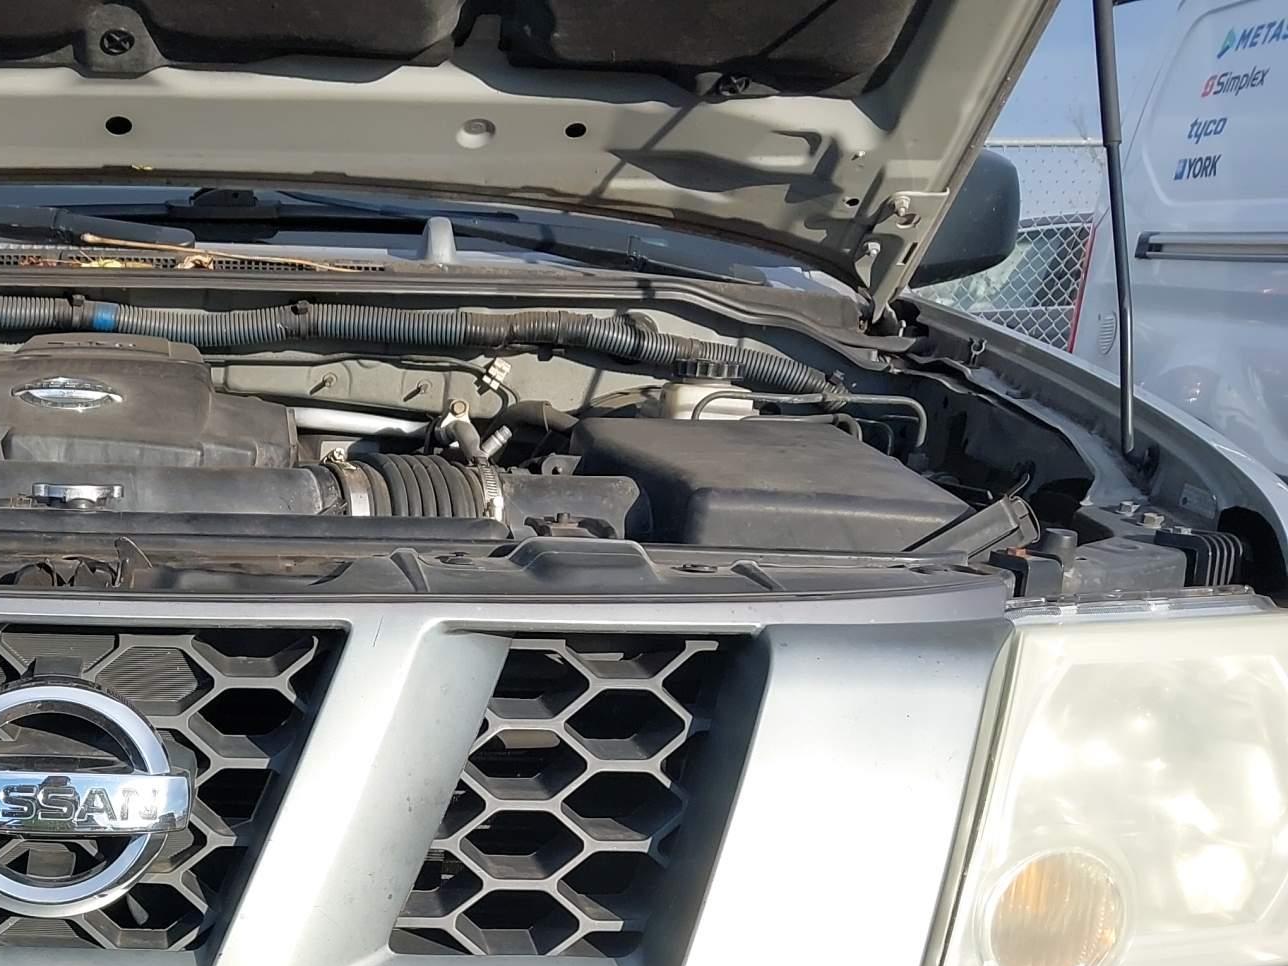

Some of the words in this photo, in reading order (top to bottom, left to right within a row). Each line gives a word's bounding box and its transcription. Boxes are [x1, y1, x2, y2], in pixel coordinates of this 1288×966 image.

[1213, 66, 1271, 96] Simplex
[1187, 117, 1228, 144] tyco
[1186, 154, 1222, 179] YORK
